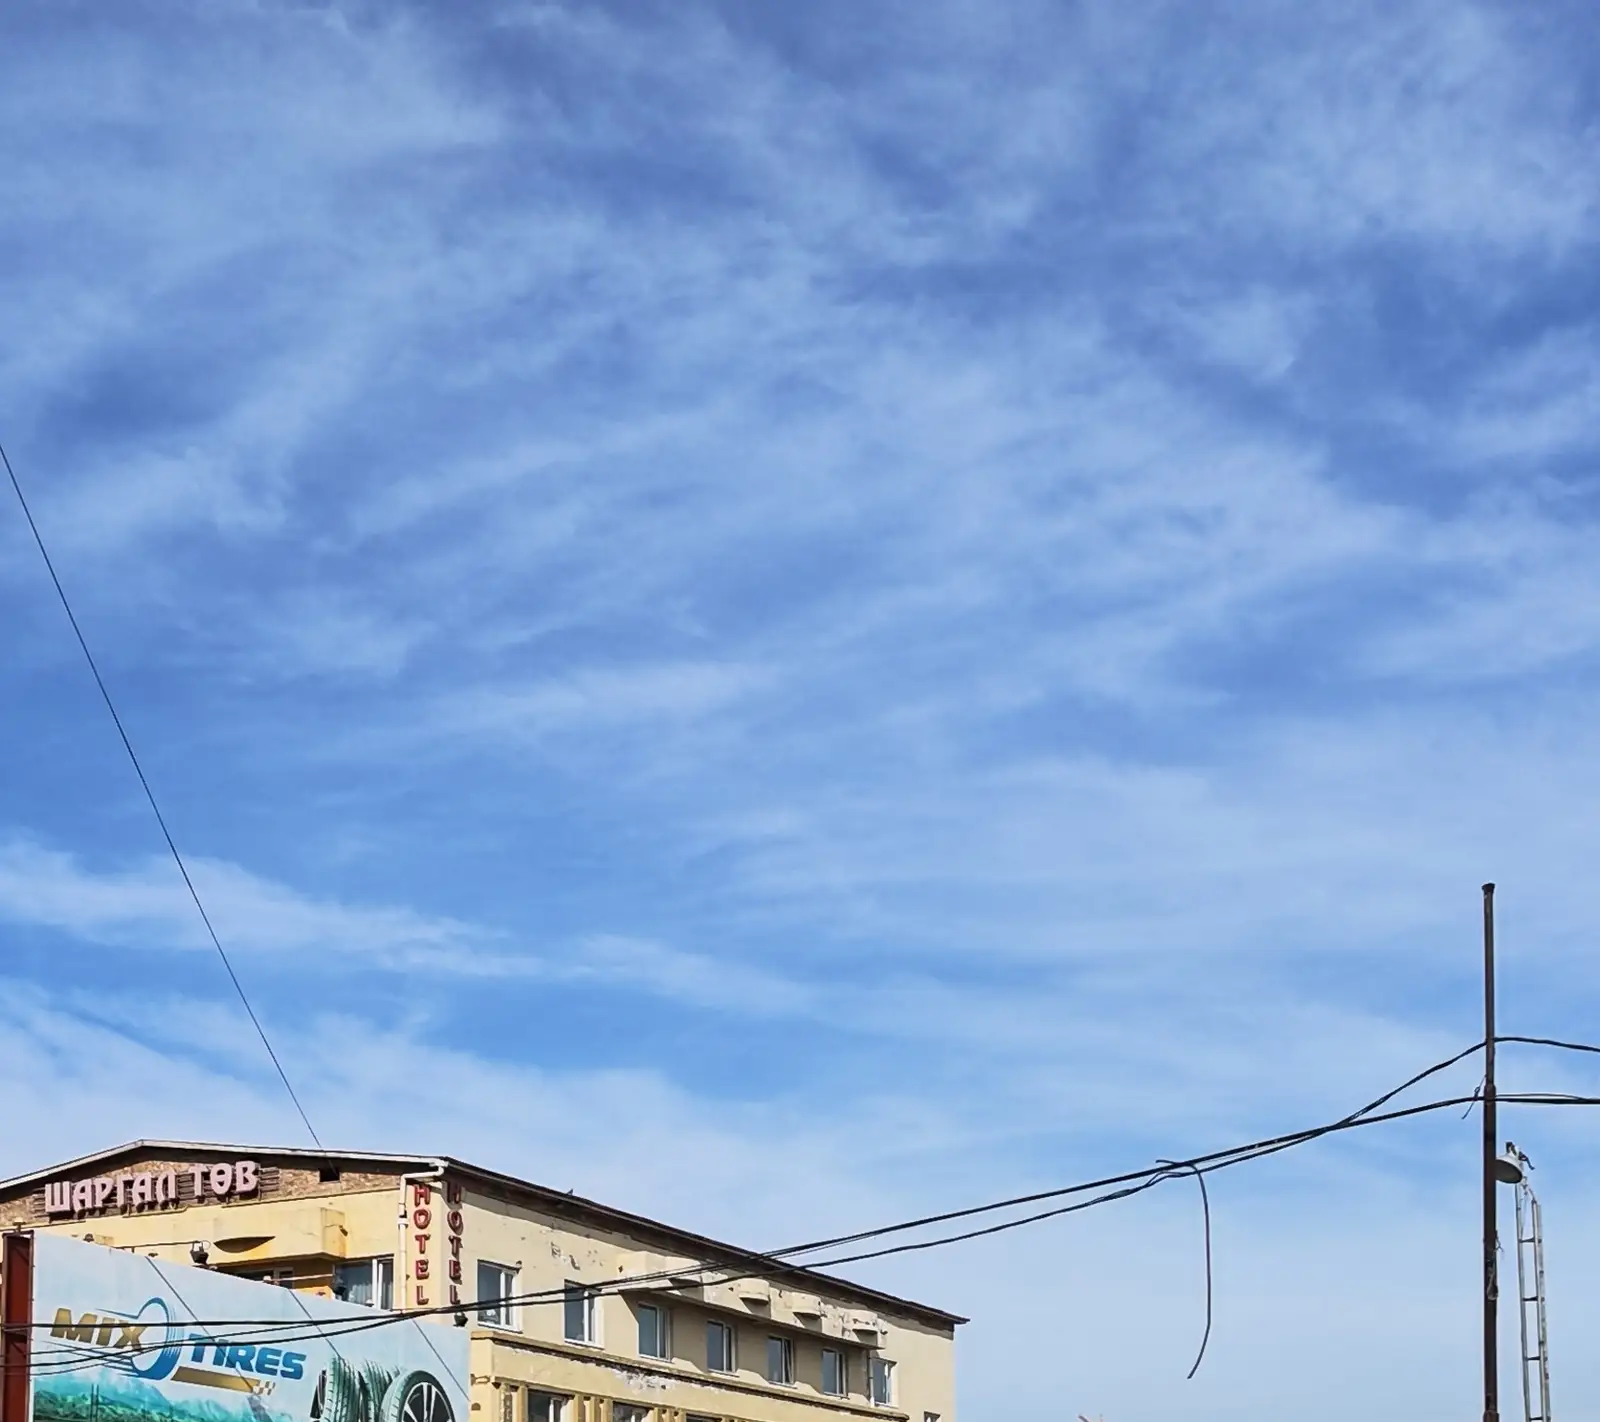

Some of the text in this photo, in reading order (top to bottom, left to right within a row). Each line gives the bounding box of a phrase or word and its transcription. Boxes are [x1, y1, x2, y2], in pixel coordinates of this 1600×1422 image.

[44, 1160, 260, 1213] ШАРГАЛ ТӨВ
[413, 1183, 432, 1306] HOTEL
[447, 1182, 464, 1306] HOTEL
[50, 1307, 307, 1380] MIX TIRES
